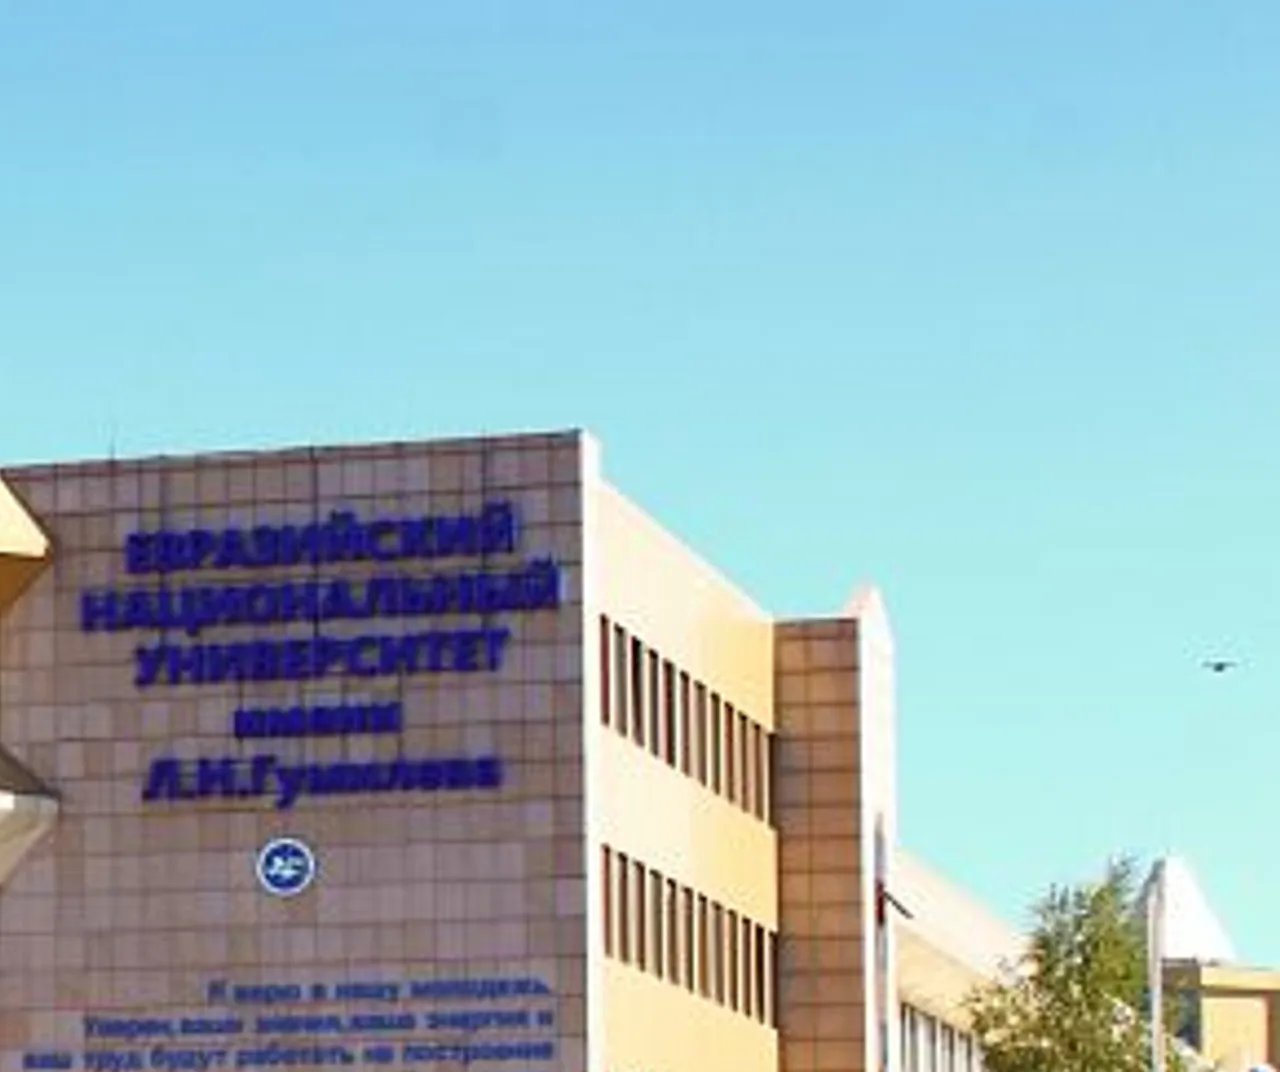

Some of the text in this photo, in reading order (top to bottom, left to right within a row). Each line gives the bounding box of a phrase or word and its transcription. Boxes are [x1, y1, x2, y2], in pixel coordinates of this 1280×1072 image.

[126, 502, 518, 574] ЕВРАЗИЙСКИЙ
[81, 555, 562, 634] НАЦИОНАЛЬНЫЙ
[135, 629, 511, 686] УНИВЕРСИТЕТ
[234, 702, 402, 738] имени
[142, 755, 503, 807] Л.Н.Гумилева
